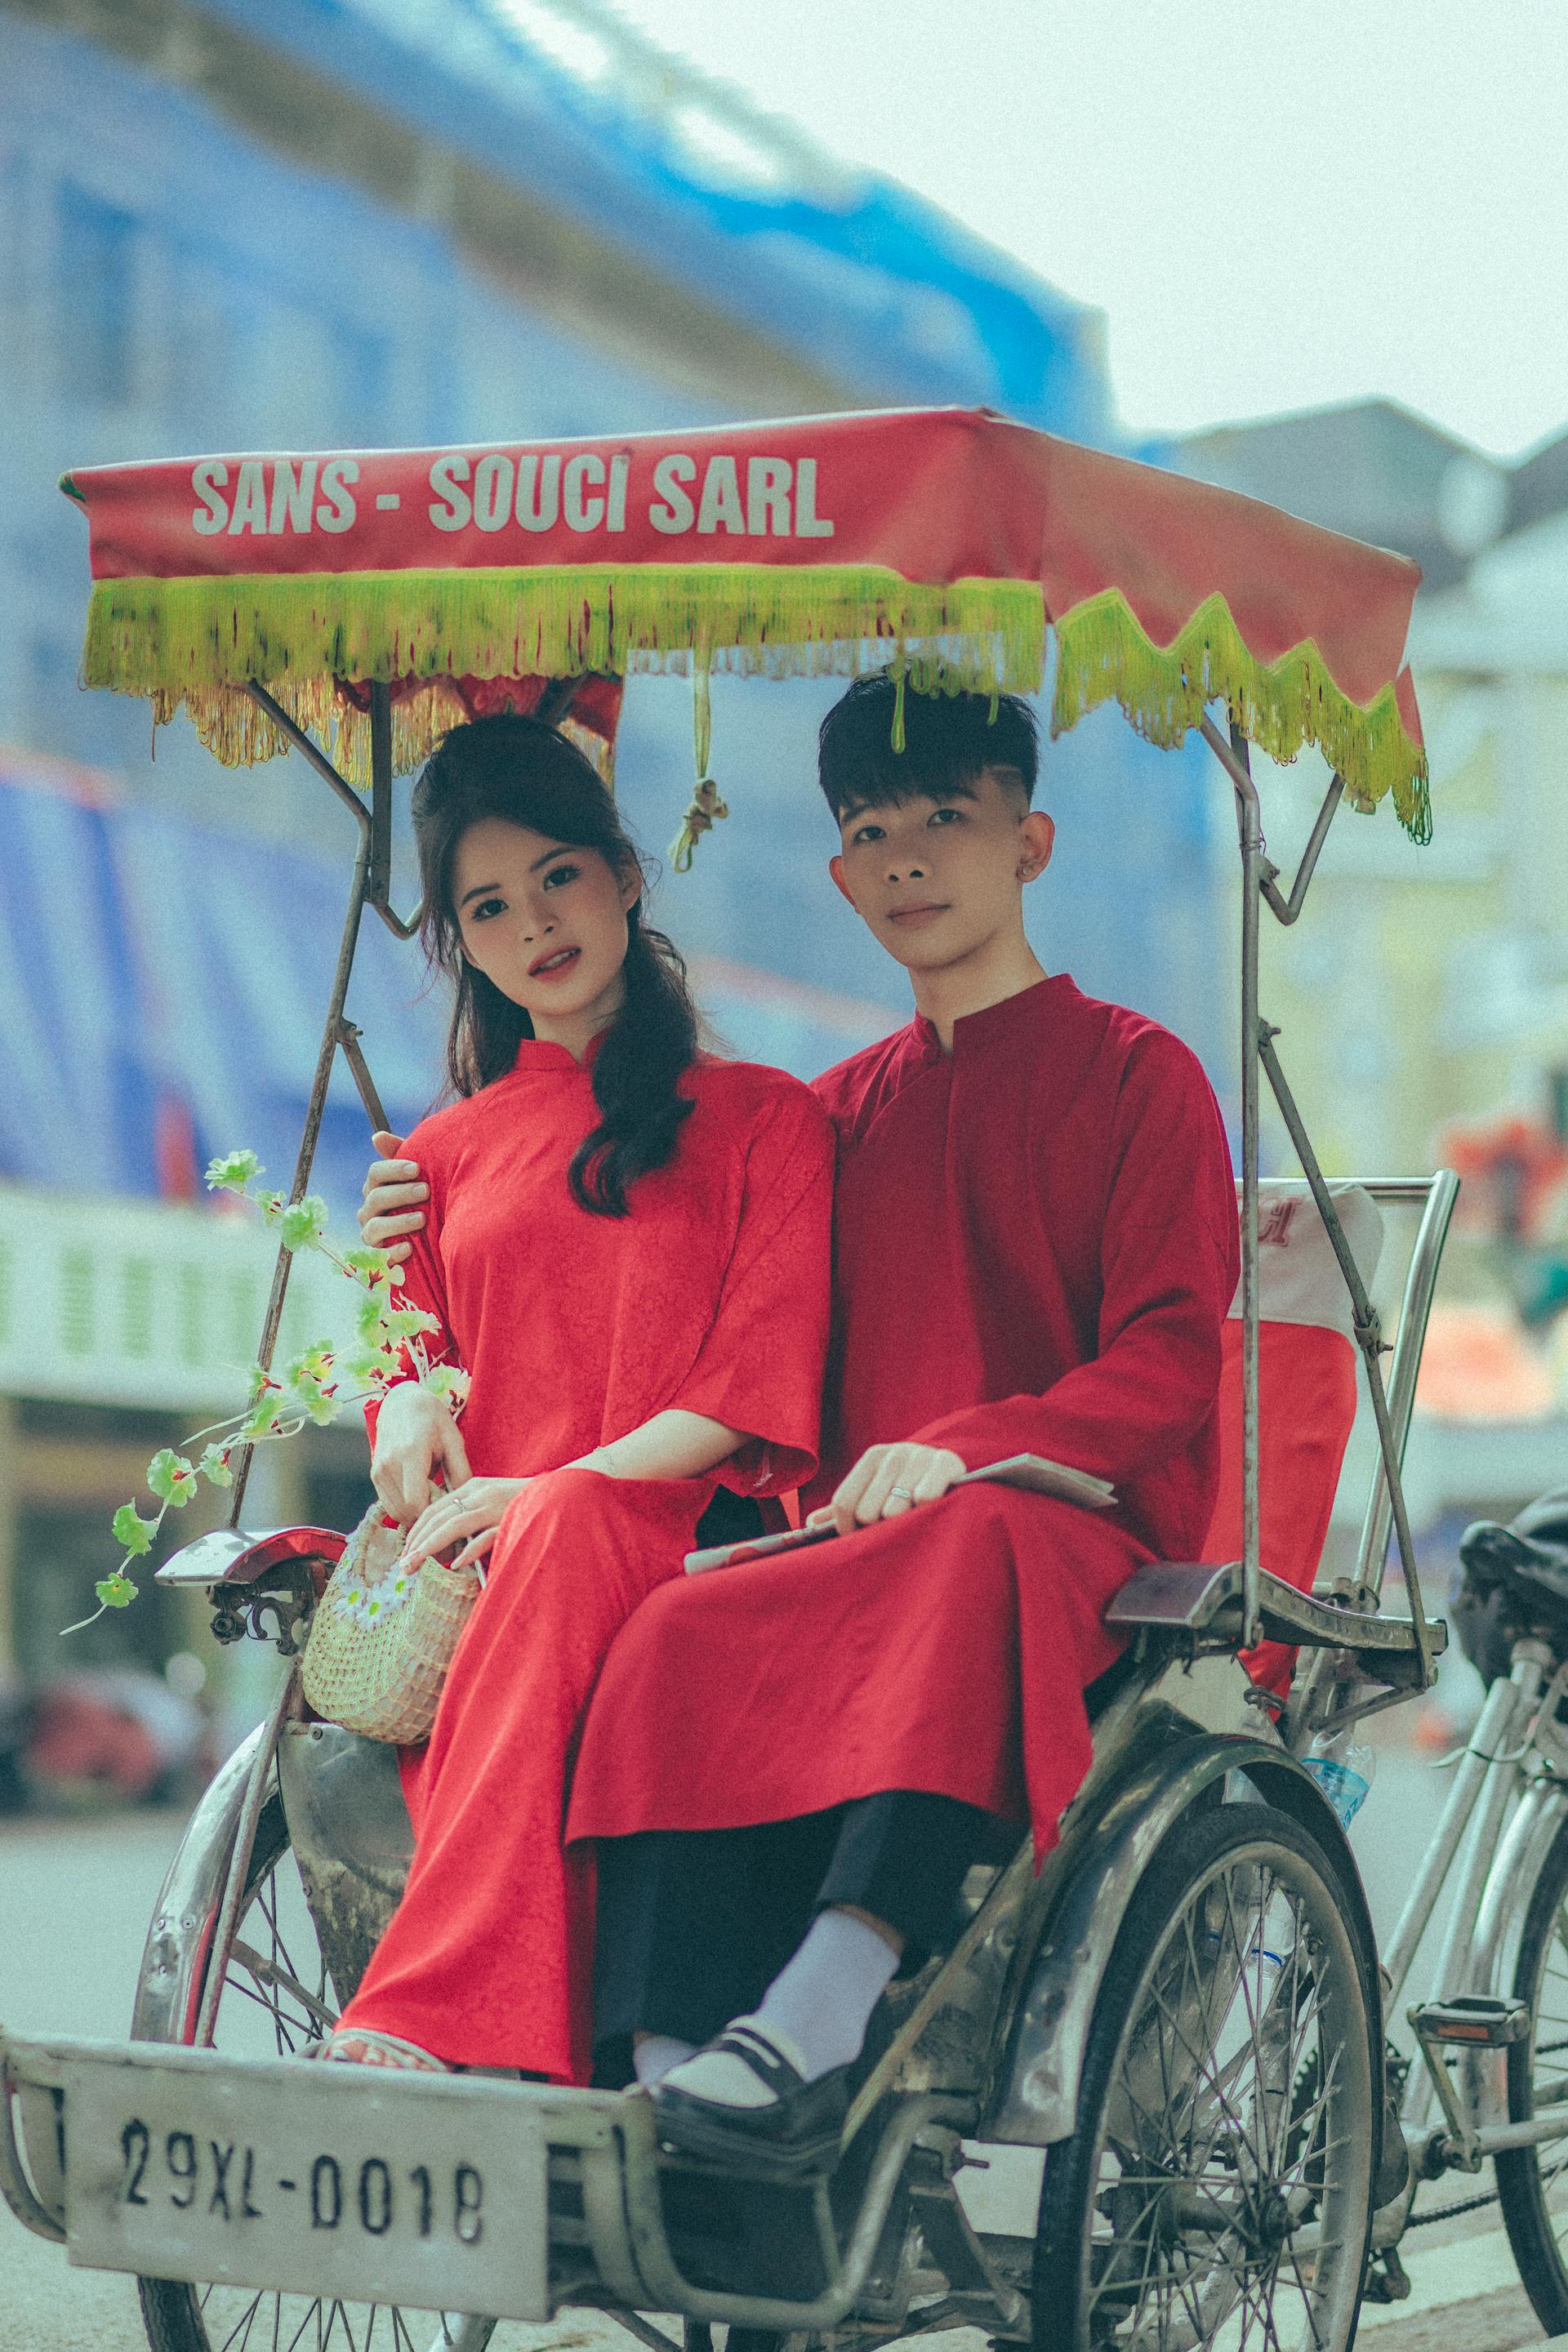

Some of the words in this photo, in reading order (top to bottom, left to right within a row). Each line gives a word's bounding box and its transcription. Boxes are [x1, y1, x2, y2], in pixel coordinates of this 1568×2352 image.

[191, 459, 359, 536] SANS
[427, 454, 630, 533] SOUCI
[649, 454, 835, 537] SARL
[121, 2118, 483, 2246] 29XL-0018
